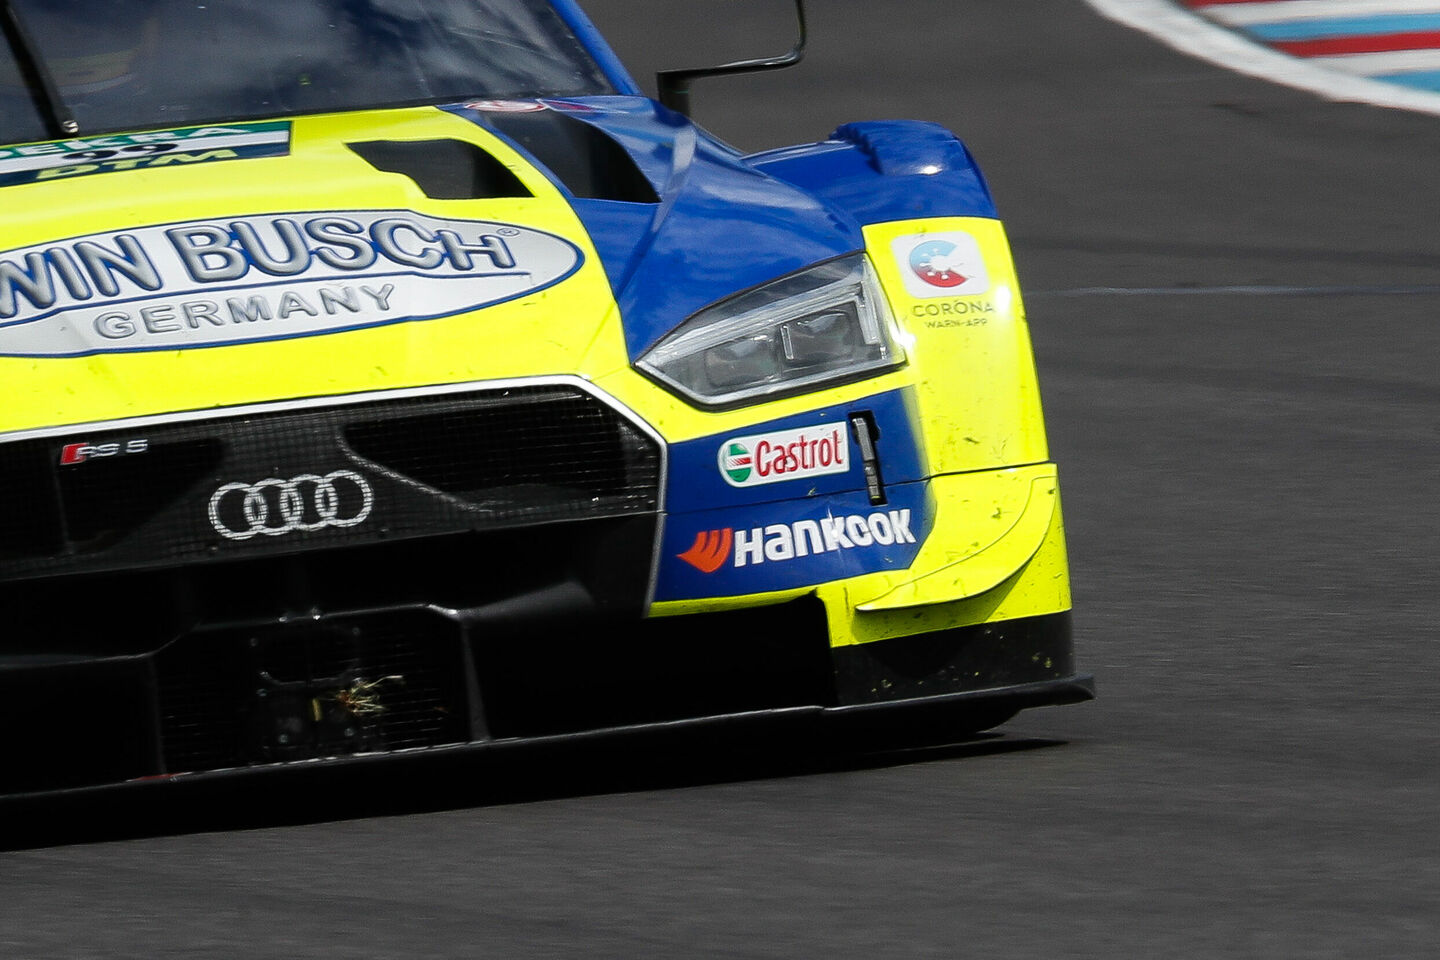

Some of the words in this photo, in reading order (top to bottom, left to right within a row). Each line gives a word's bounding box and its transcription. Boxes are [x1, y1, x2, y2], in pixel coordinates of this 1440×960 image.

[36, 148, 238, 180] DTM
[164, 216, 520, 283] BUSCH
[93, 282, 396, 339] GERMANY
[911, 301, 995, 318] CORONA
[125, 439, 148, 453] 5
[755, 429, 844, 478] Castrol
